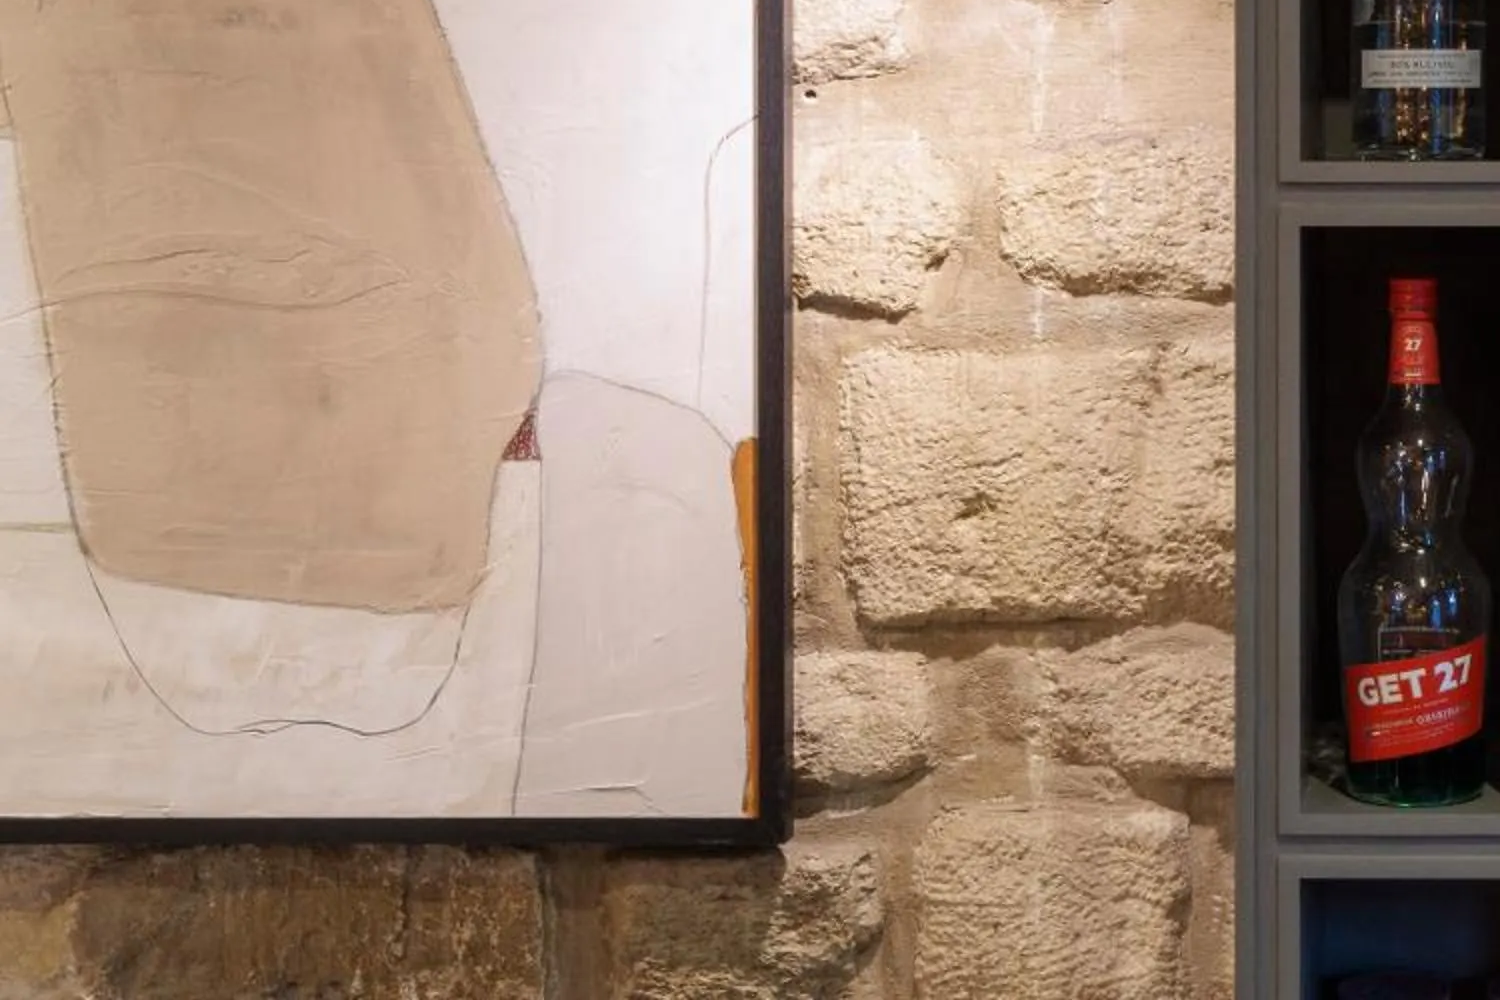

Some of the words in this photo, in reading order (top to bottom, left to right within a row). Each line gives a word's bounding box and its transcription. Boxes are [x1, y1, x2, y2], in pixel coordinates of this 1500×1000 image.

[1403, 338, 1423, 351] 27
[1357, 668, 1427, 707] GET
[1433, 654, 1472, 693] 27
